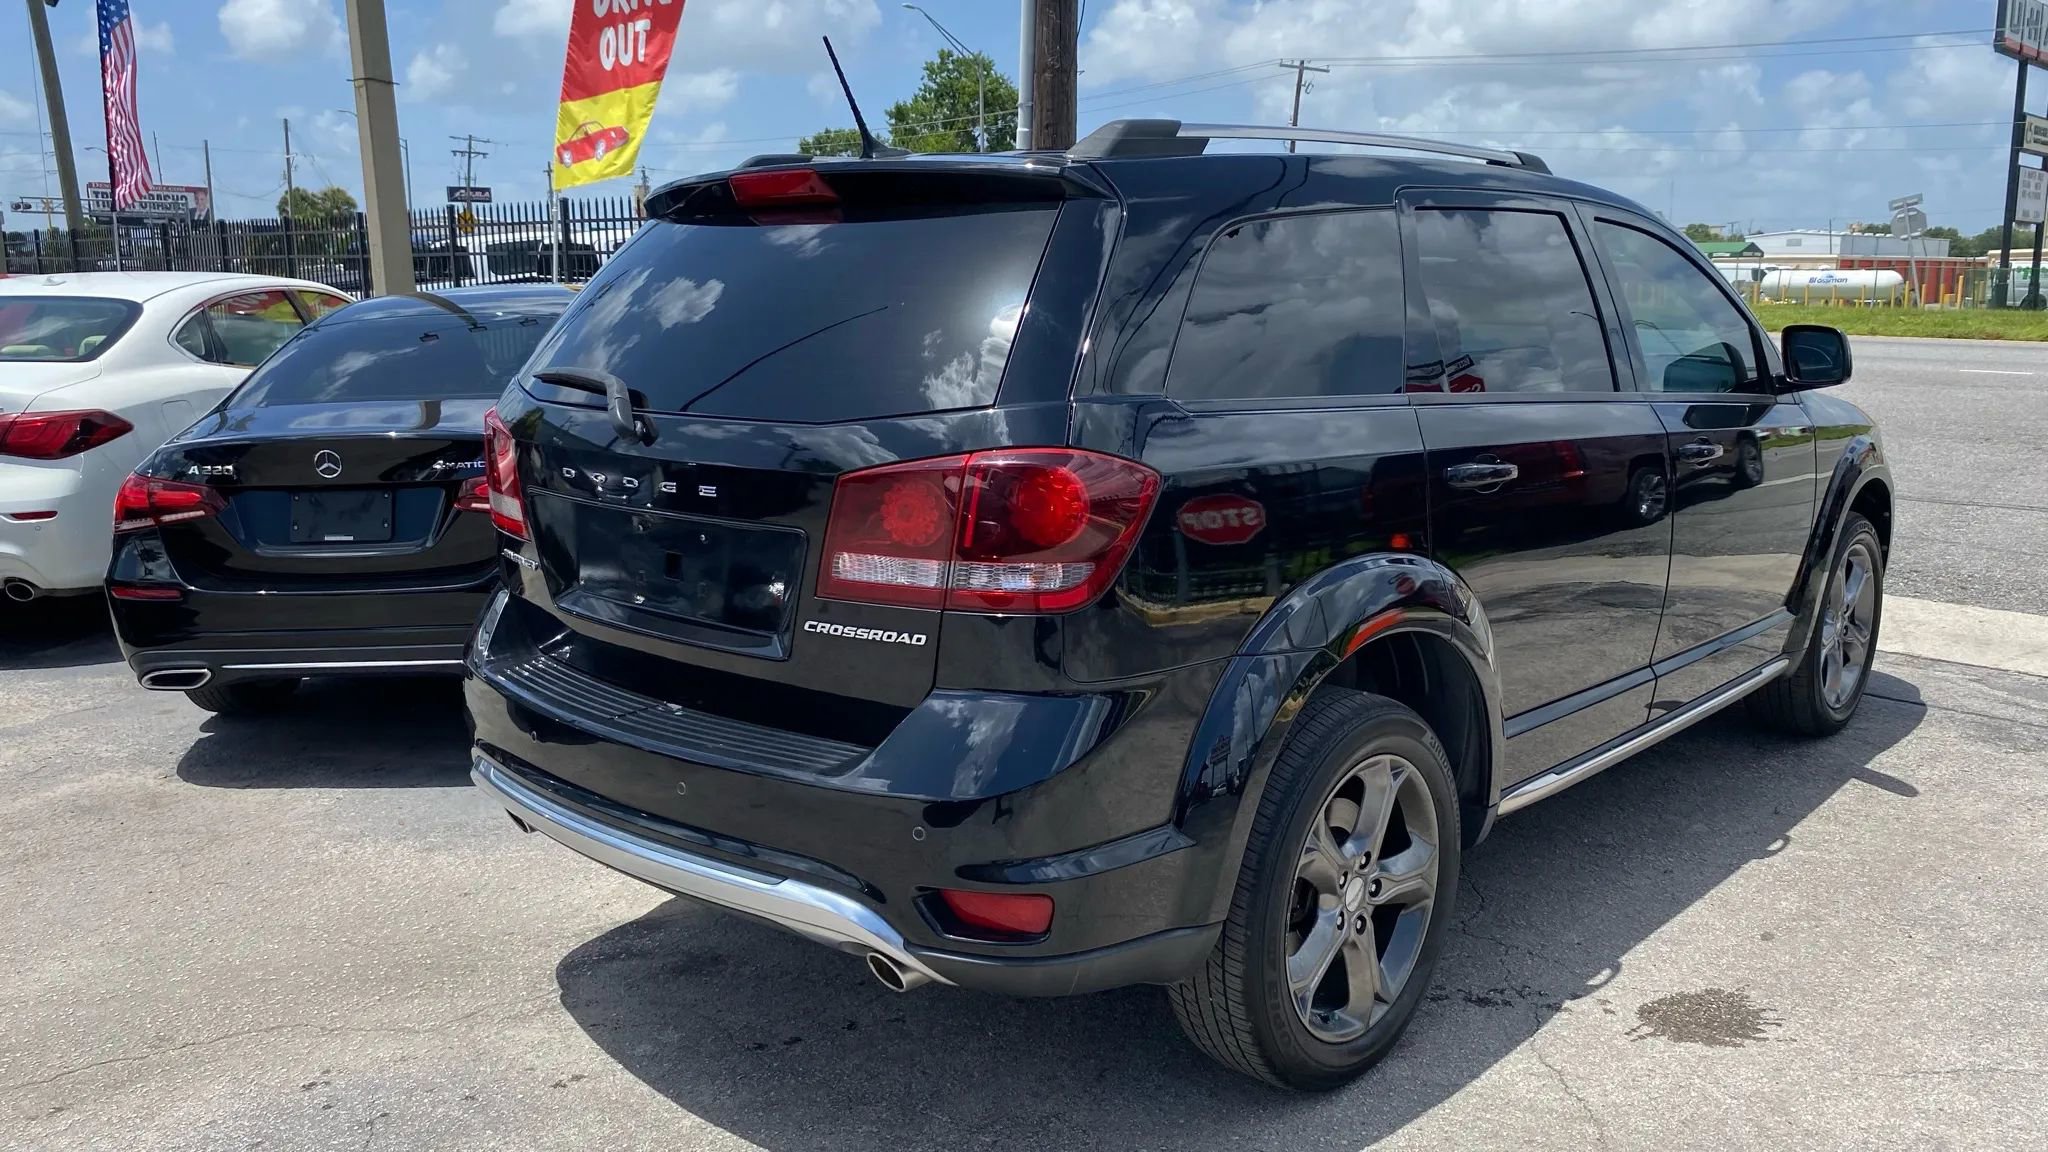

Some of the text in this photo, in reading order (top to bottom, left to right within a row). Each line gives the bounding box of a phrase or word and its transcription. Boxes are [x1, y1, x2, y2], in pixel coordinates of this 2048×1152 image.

[599, 19, 651, 71] OUT
[188, 465, 233, 475] A 220
[562, 467, 717, 497] DODGE
[803, 620, 927, 646] CROSSROAD
